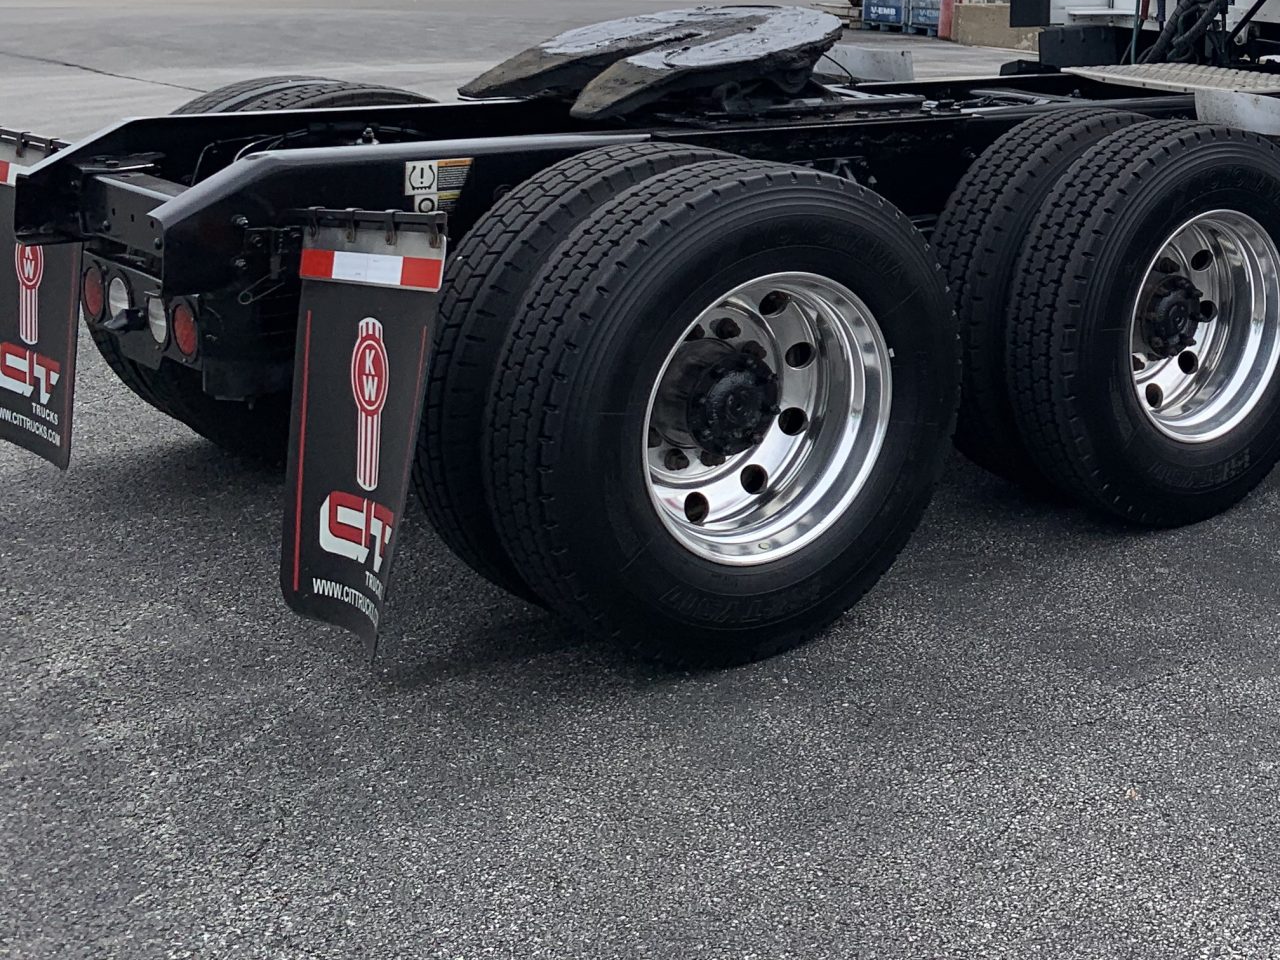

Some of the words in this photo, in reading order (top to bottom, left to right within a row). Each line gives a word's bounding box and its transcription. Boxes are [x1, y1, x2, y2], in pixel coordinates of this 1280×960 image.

[870, 6, 896, 15] V-EMB
[31, 402, 59, 426] TRUCKS
[319, 490, 394, 574] CIT
